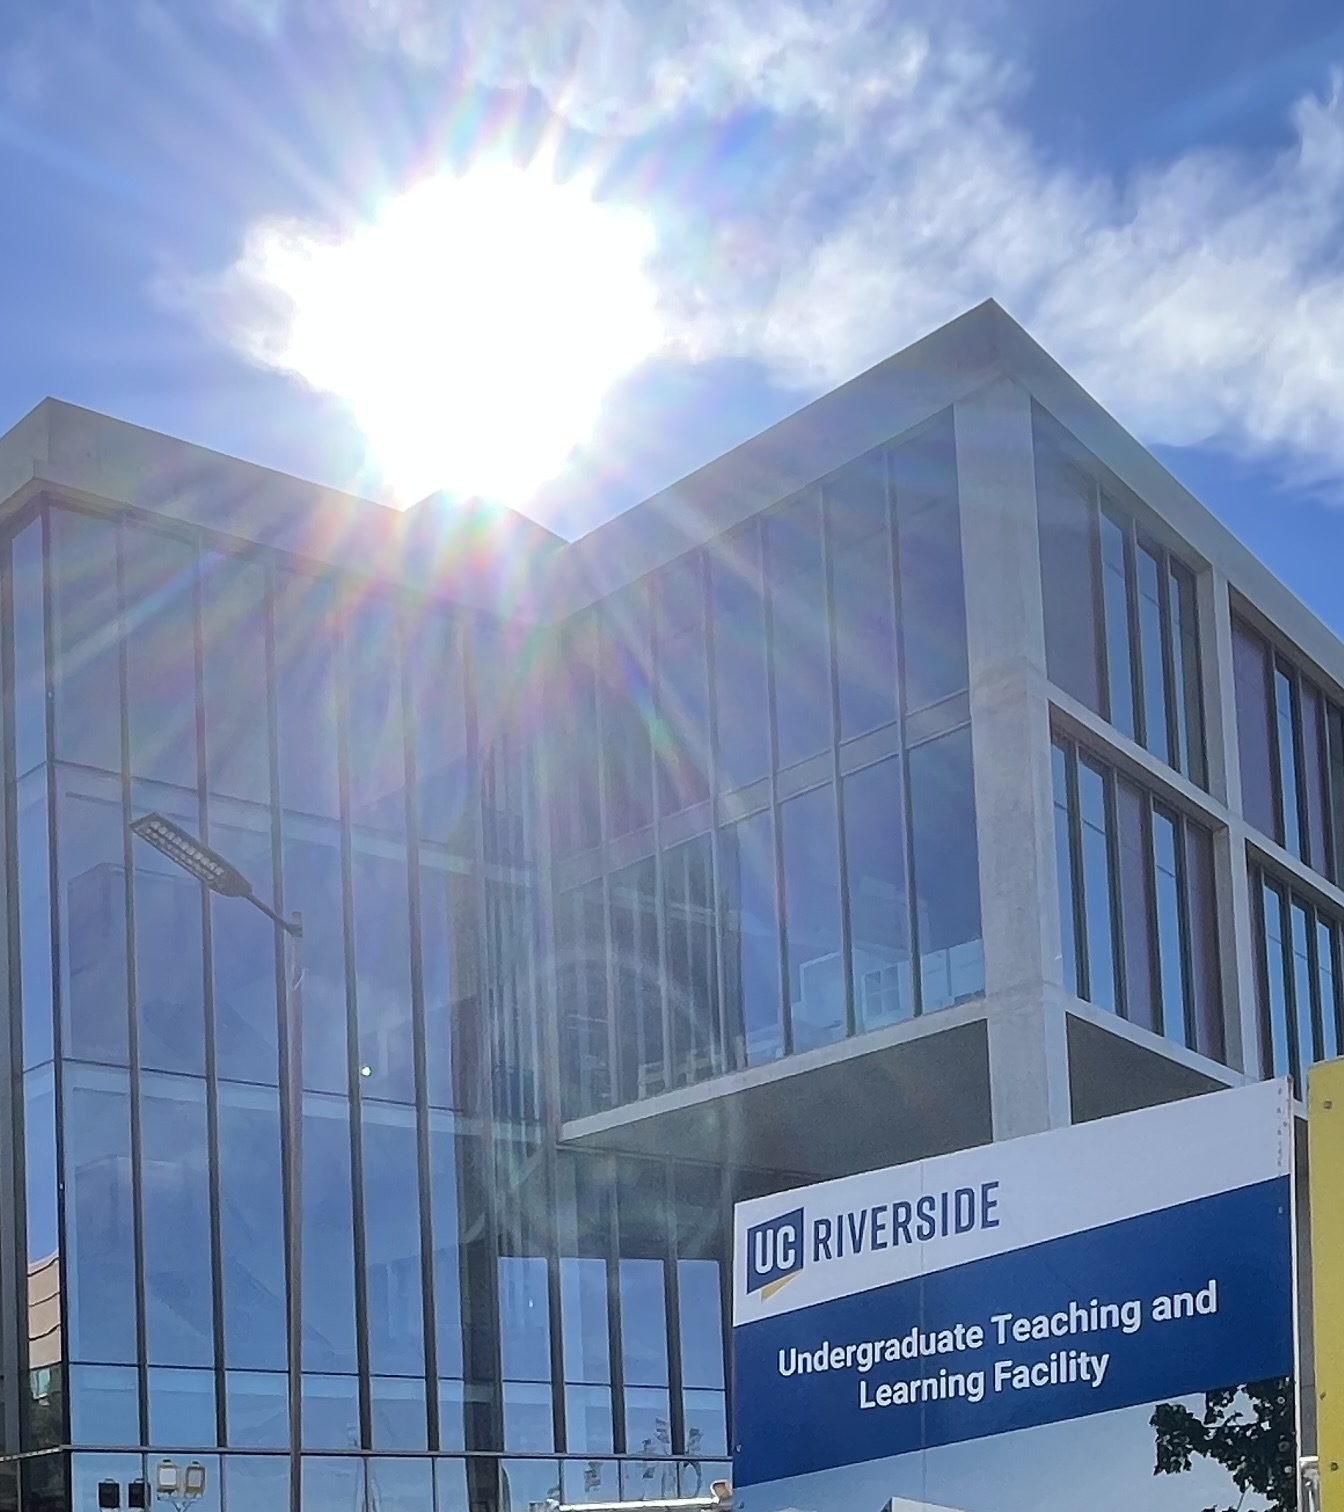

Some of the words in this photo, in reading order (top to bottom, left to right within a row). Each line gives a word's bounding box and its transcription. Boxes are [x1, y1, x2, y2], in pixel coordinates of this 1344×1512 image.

[754, 1222, 796, 1274] UC
[813, 1180, 1001, 1263] RIVERSIDE
[778, 1323, 984, 1377] Undergraduate
[991, 1296, 1142, 1346] Teaching
[1151, 1279, 1218, 1322] and
[859, 1367, 985, 1410] Learning
[993, 1351, 1110, 1394] Facility
